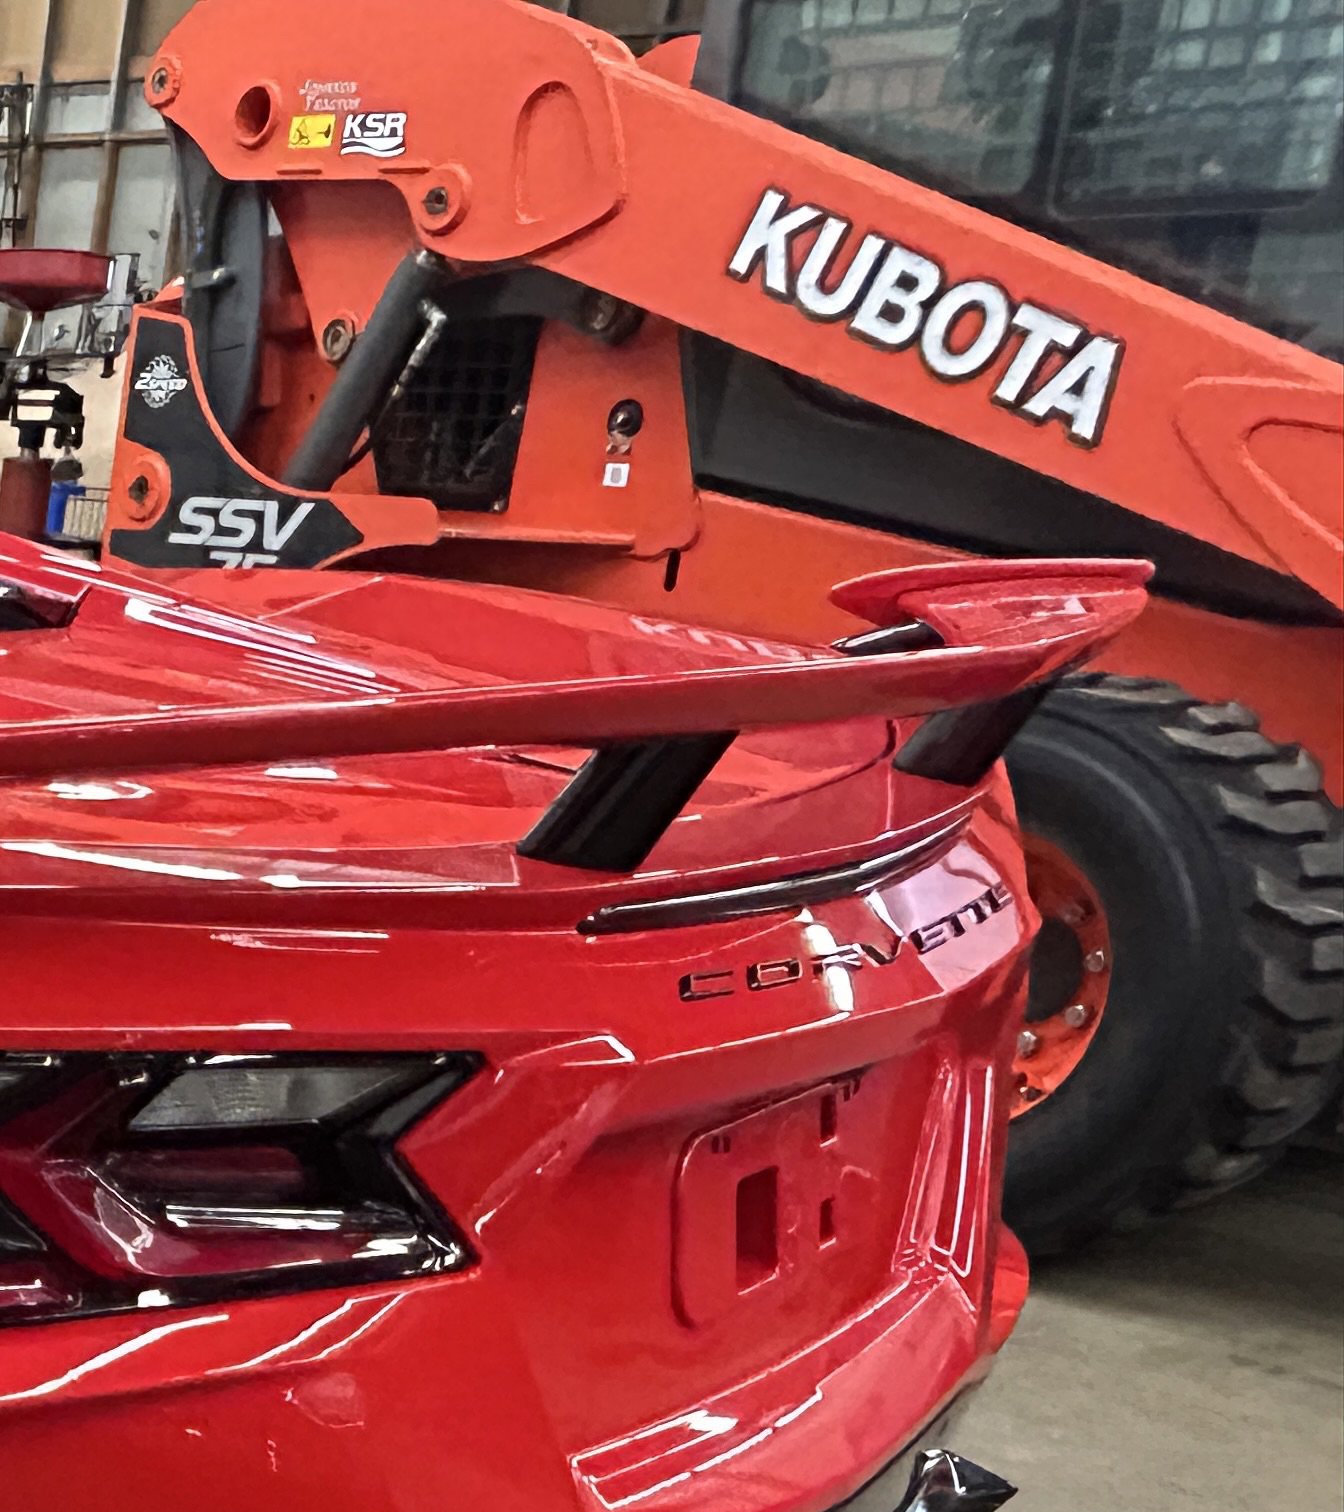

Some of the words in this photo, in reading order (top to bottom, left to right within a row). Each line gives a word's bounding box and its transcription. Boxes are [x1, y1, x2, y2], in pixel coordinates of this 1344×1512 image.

[342, 112, 407, 138] KSR
[726, 187, 1123, 446] KUBOTA
[167, 496, 316, 550] SSV
[678, 882, 1014, 1002] CORVETTE
